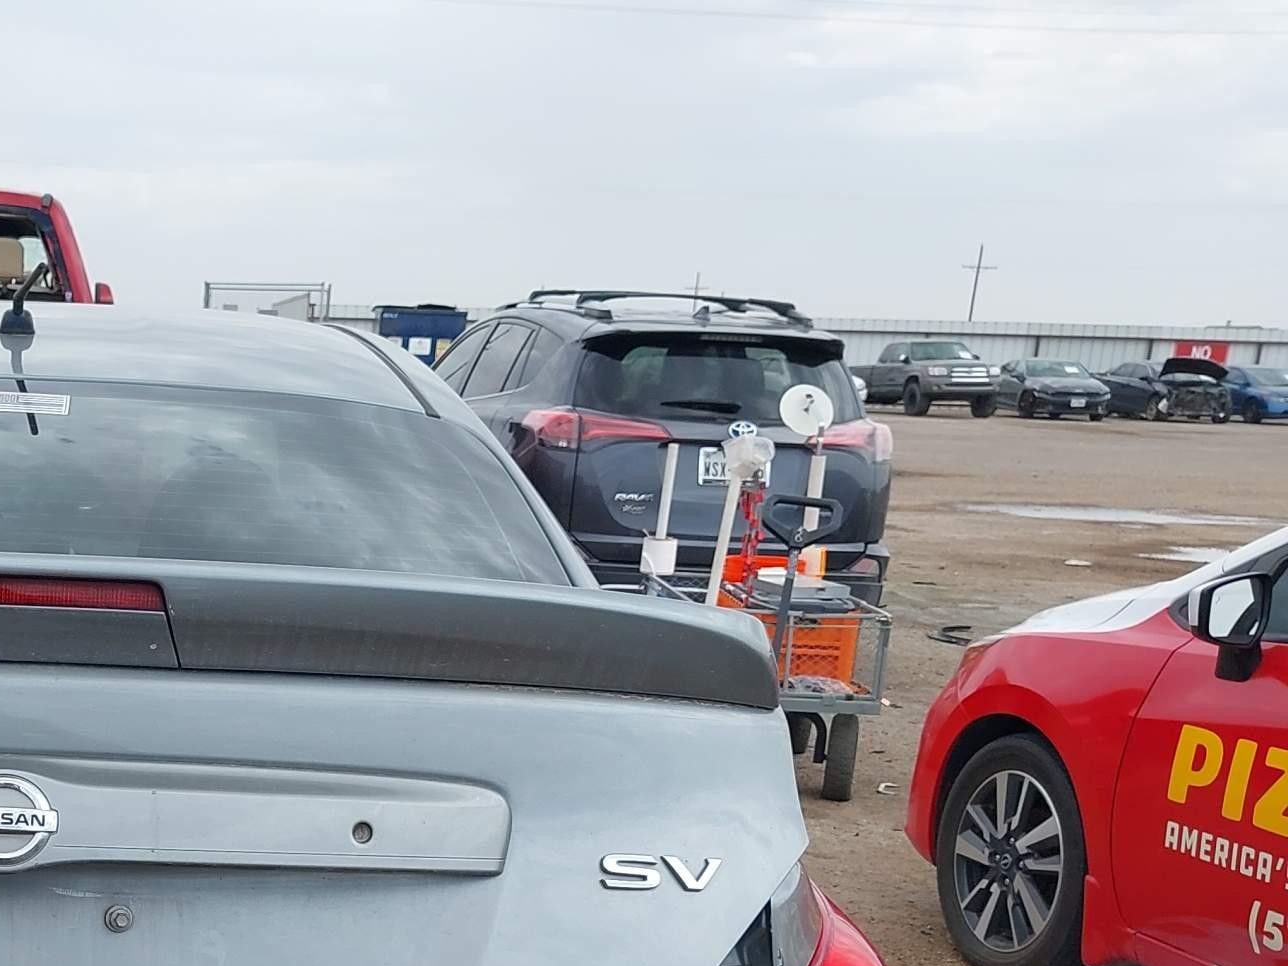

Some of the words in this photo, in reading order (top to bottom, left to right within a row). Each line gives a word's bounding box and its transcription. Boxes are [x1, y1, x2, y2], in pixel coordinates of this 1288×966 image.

[1191, 345, 1212, 360] NO
[599, 853, 722, 892] SV
[1164, 820, 1288, 890] AMERICA'
[1248, 900, 1288, 955] (5
